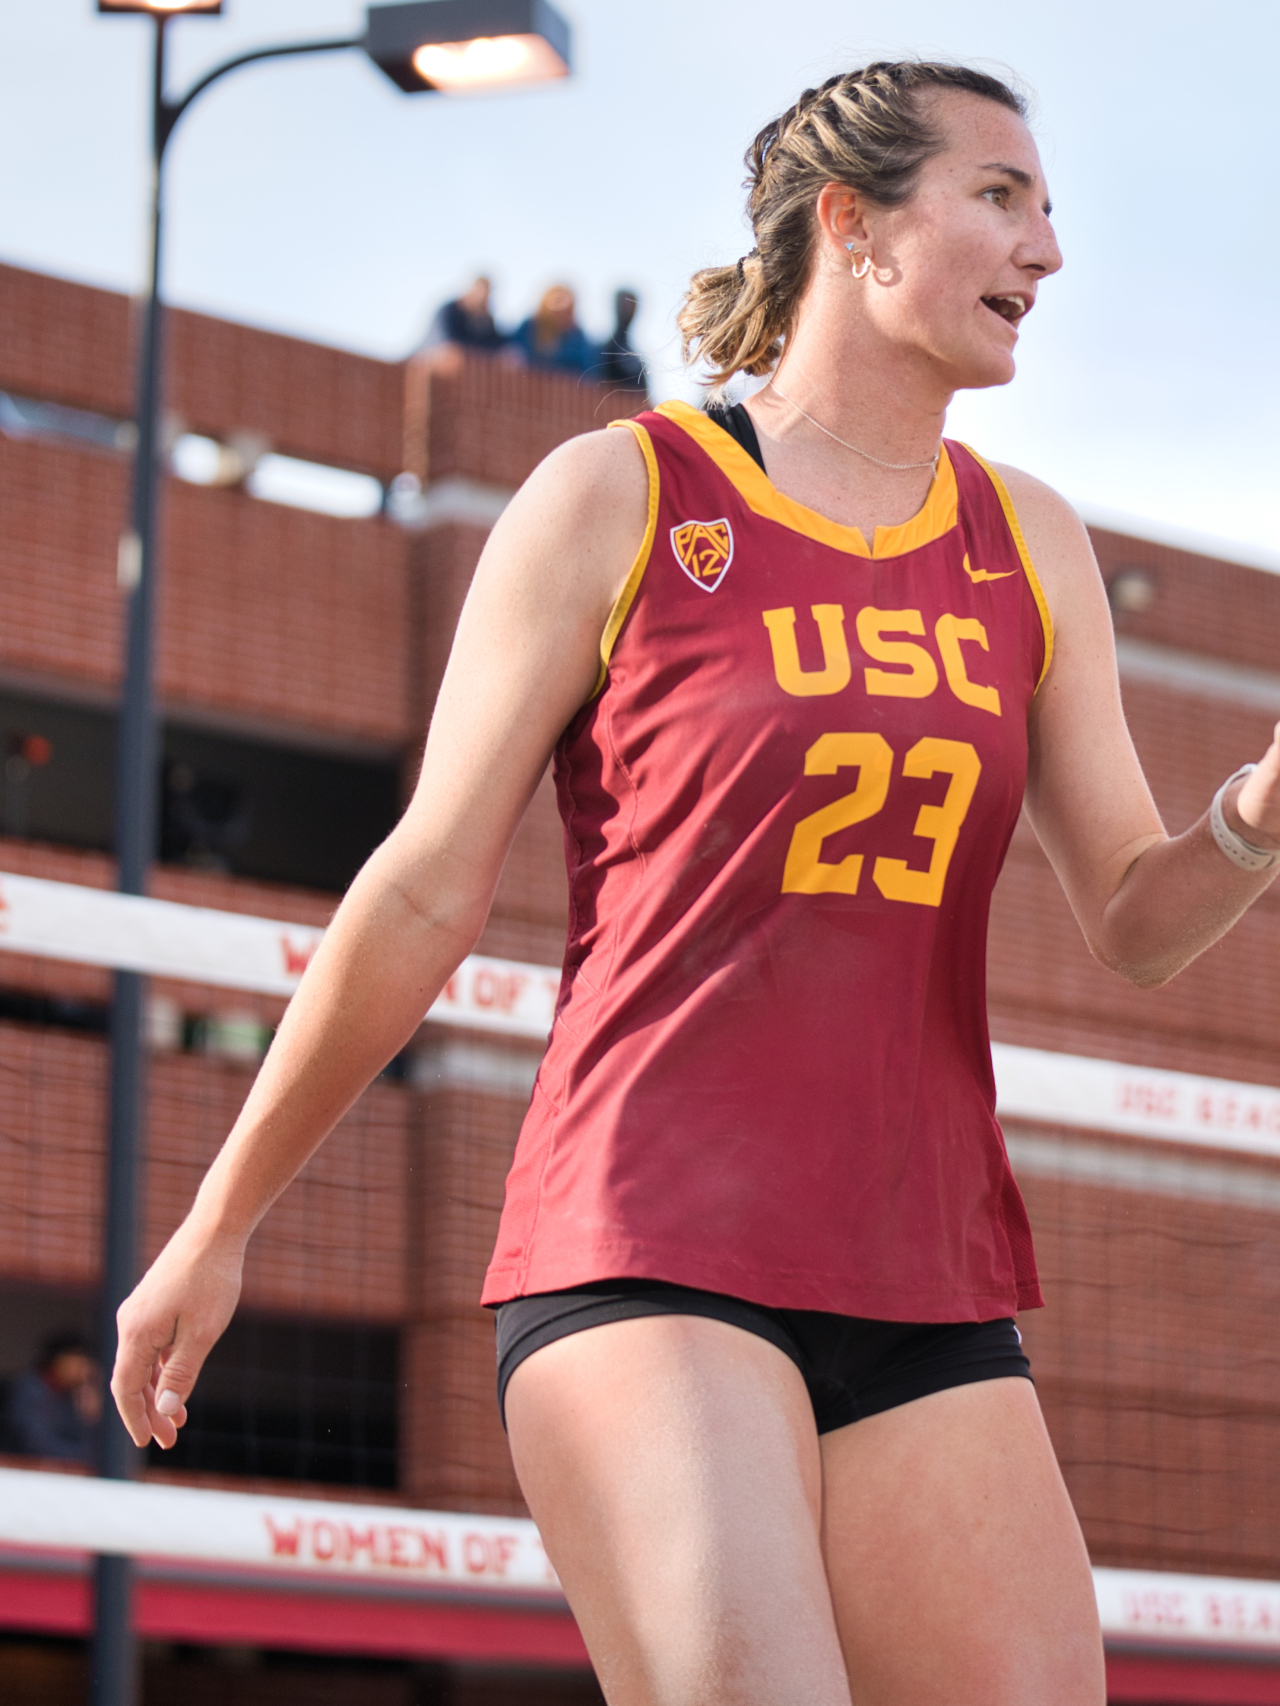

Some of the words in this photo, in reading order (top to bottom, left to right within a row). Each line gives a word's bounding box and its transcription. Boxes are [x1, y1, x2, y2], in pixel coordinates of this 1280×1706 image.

[674, 523, 729, 567] PAC
[691, 548, 722, 578] 12
[762, 603, 1002, 717] USC
[780, 731, 982, 908] 23
[472, 971, 526, 1014] OF
[264, 1513, 448, 1571] WOMEN
[463, 1531, 520, 1575] OF
